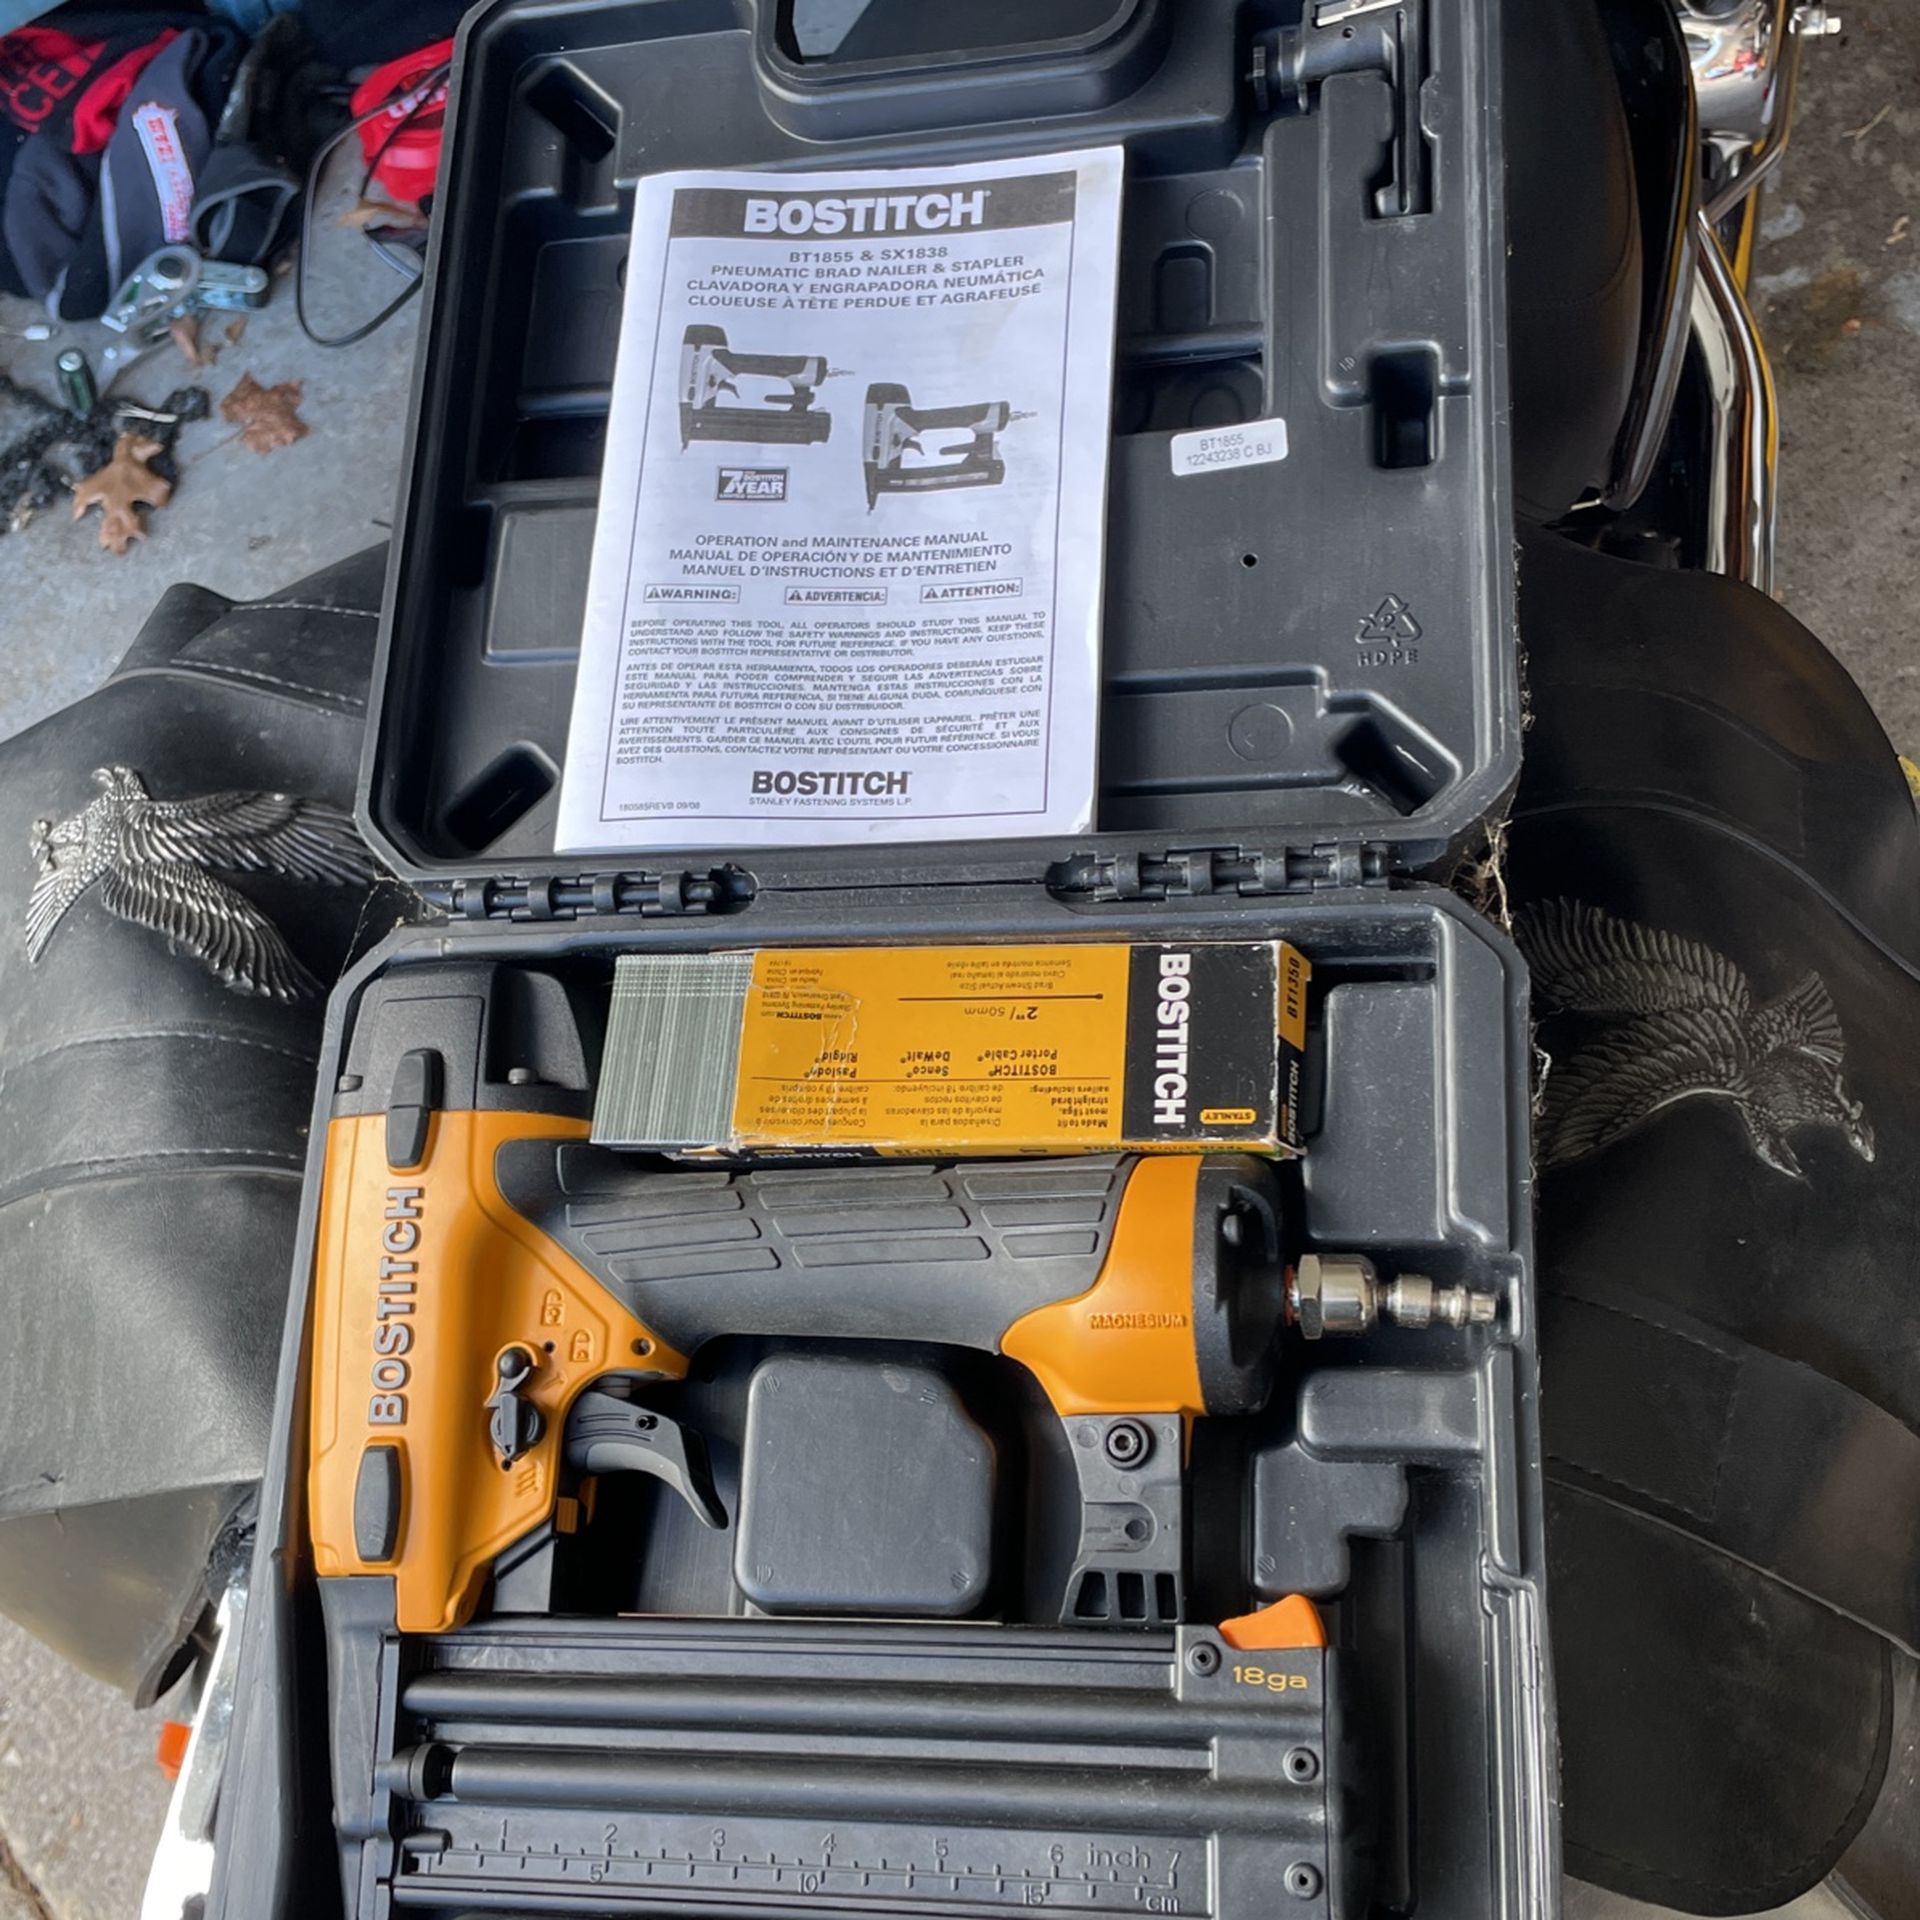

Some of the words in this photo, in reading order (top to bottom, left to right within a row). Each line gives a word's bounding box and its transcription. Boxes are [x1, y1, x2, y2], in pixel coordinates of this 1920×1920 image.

[744, 190, 984, 234] BOSTITCH
[790, 251, 853, 263] BT1855
[860, 250, 873, 261] &
[881, 247, 948, 260] SX1838
[712, 265, 809, 278] PNEUMATIC
[816, 267, 861, 278] BRAD
[867, 264, 927, 276] NAILER
[933, 263, 945, 274] &
[952, 256, 1023, 272] STAPLER
[688, 280, 789, 293] CLAVADORA
[793, 283, 803, 293] Y
[810, 281, 937, 293] ENGRAPADORA
[944, 268, 1044, 288] NEUMÁTICA
[688, 296, 776, 308] CLOUEUSE
[782, 297, 794, 309] À
[799, 297, 837, 309] TÊTE
[844, 297, 910, 308] PERDUE
[917, 295, 936, 306] ET
[941, 283, 1040, 304] AGRAFEUSE
[1200, 434, 1244, 451] BT1855
[735, 482, 783, 493] YEAR
[696, 535, 778, 547] OPERATION
[782, 538, 807, 547] and
[812, 535, 920, 548] MAINTENANCE
[924, 531, 988, 545] MANUAL
[670, 550, 733, 561] MANUAL
[738, 551, 757, 561] DE
[762, 551, 846, 563] OPERACIÓN
[852, 553, 859, 562] Y
[864, 553, 883, 563] DE
[887, 544, 1012, 562] MANTENIMIENTO
[682, 565, 746, 576] MANUEL
[750, 566, 875, 578] D'INSTRUCTIONS
[880, 567, 897, 577] ET
[902, 560, 997, 577] D'ENTRETIEN
[661, 589, 736, 600] WARNING:
[805, 591, 885, 601] ADVERTENCIA:
[941, 583, 1020, 598] ATTENTION:
[631, 619, 666, 627] BEFORE
[758, 621, 783, 629] TOOL,
[877, 621, 916, 629] SHOULD
[922, 619, 954, 627] STUDY
[959, 617, 980, 625] THIS
[986, 614, 1027, 623] MANUAL
[1033, 611, 1046, 619] TO
[631, 629, 694, 637] UNDERSTAND
[723, 630, 761, 638] FOLLOW
[829, 631, 881, 639] WARNINGS
[910, 627, 982, 637] INSTRUCTIONS.
[988, 624, 1012, 633] KEEP
[1015, 621, 1045, 630] THESE
[629, 638, 698, 646] INSTRUCTIONS
[728, 639, 745, 647] THE
[800, 640, 837, 648] FUTURE
[841, 640, 896, 648] REFERENCE.
[935, 637, 959, 645] HAVE
[962, 636, 983, 644] ANY
[986, 630, 1045, 642] QUESTIONS,
[629, 648, 671, 656] CONTACT
[673, 648, 698, 656] YOUR
[751, 649, 831, 658] REPRESENTATIVE
[835, 650, 848, 658] OR
[851, 649, 914, 658] DISTRIBUTOR.
[1358, 649, 1418, 667] HDPE
[627, 663, 657, 671] ANTES
[677, 663, 712, 671] OPERAR
[746, 664, 817, 673] HERRAMIENTA,
[820, 665, 852, 673] TODOS
[879, 663, 943, 672] OPERADORES
[947, 659, 992, 670] DEBERÁN
[996, 656, 1043, 666] ESTUDIAR
[775, 673, 843, 682] COMPRENDER
[862, 674, 898, 682] SEGUIR
[905, 673, 923, 681] LAS
[929, 669, 1003, 680] ADVERTENCIAS
[1010, 665, 1042, 675] SOBRE
[752, 771, 907, 795] BOSTITCH
[676, 802, 700, 810] 09/08
[749, 797, 791, 806] STANLEY
[793, 798, 847, 806] FASTENING
[850, 798, 894, 806] SYSTEMS
[965, 1006, 1005, 1016] 50mm
[1154, 954, 1191, 1123] BOSTITCH
[1021, 1049, 1057, 1060] Porter
[1075, 1095, 1108, 1105] straight
[1085, 1108, 1108, 1116] most
[1205, 1112, 1252, 1120] STANLEY
[1080, 1119, 1108, 1128] Made
[368, 1187, 425, 1426] BOSTITCH
[1089, 1313, 1188, 1330] MAGNESIUM
[1232, 1665, 1309, 1692] 18ga
[604, 1824, 619, 1843] 2
[711, 1828, 727, 1847] 3
[821, 1832, 838, 1850] 4
[933, 1838, 949, 1857] 5
[1049, 1843, 1065, 1863] 6
[1088, 1843, 1151, 1869] inch
[1169, 1849, 1182, 1871] 7
[589, 1863, 603, 1882] 5
[799, 1872, 818, 1893] 10
[1023, 1885, 1045, 1904] 15
[1146, 1895, 1180, 1913] cm
